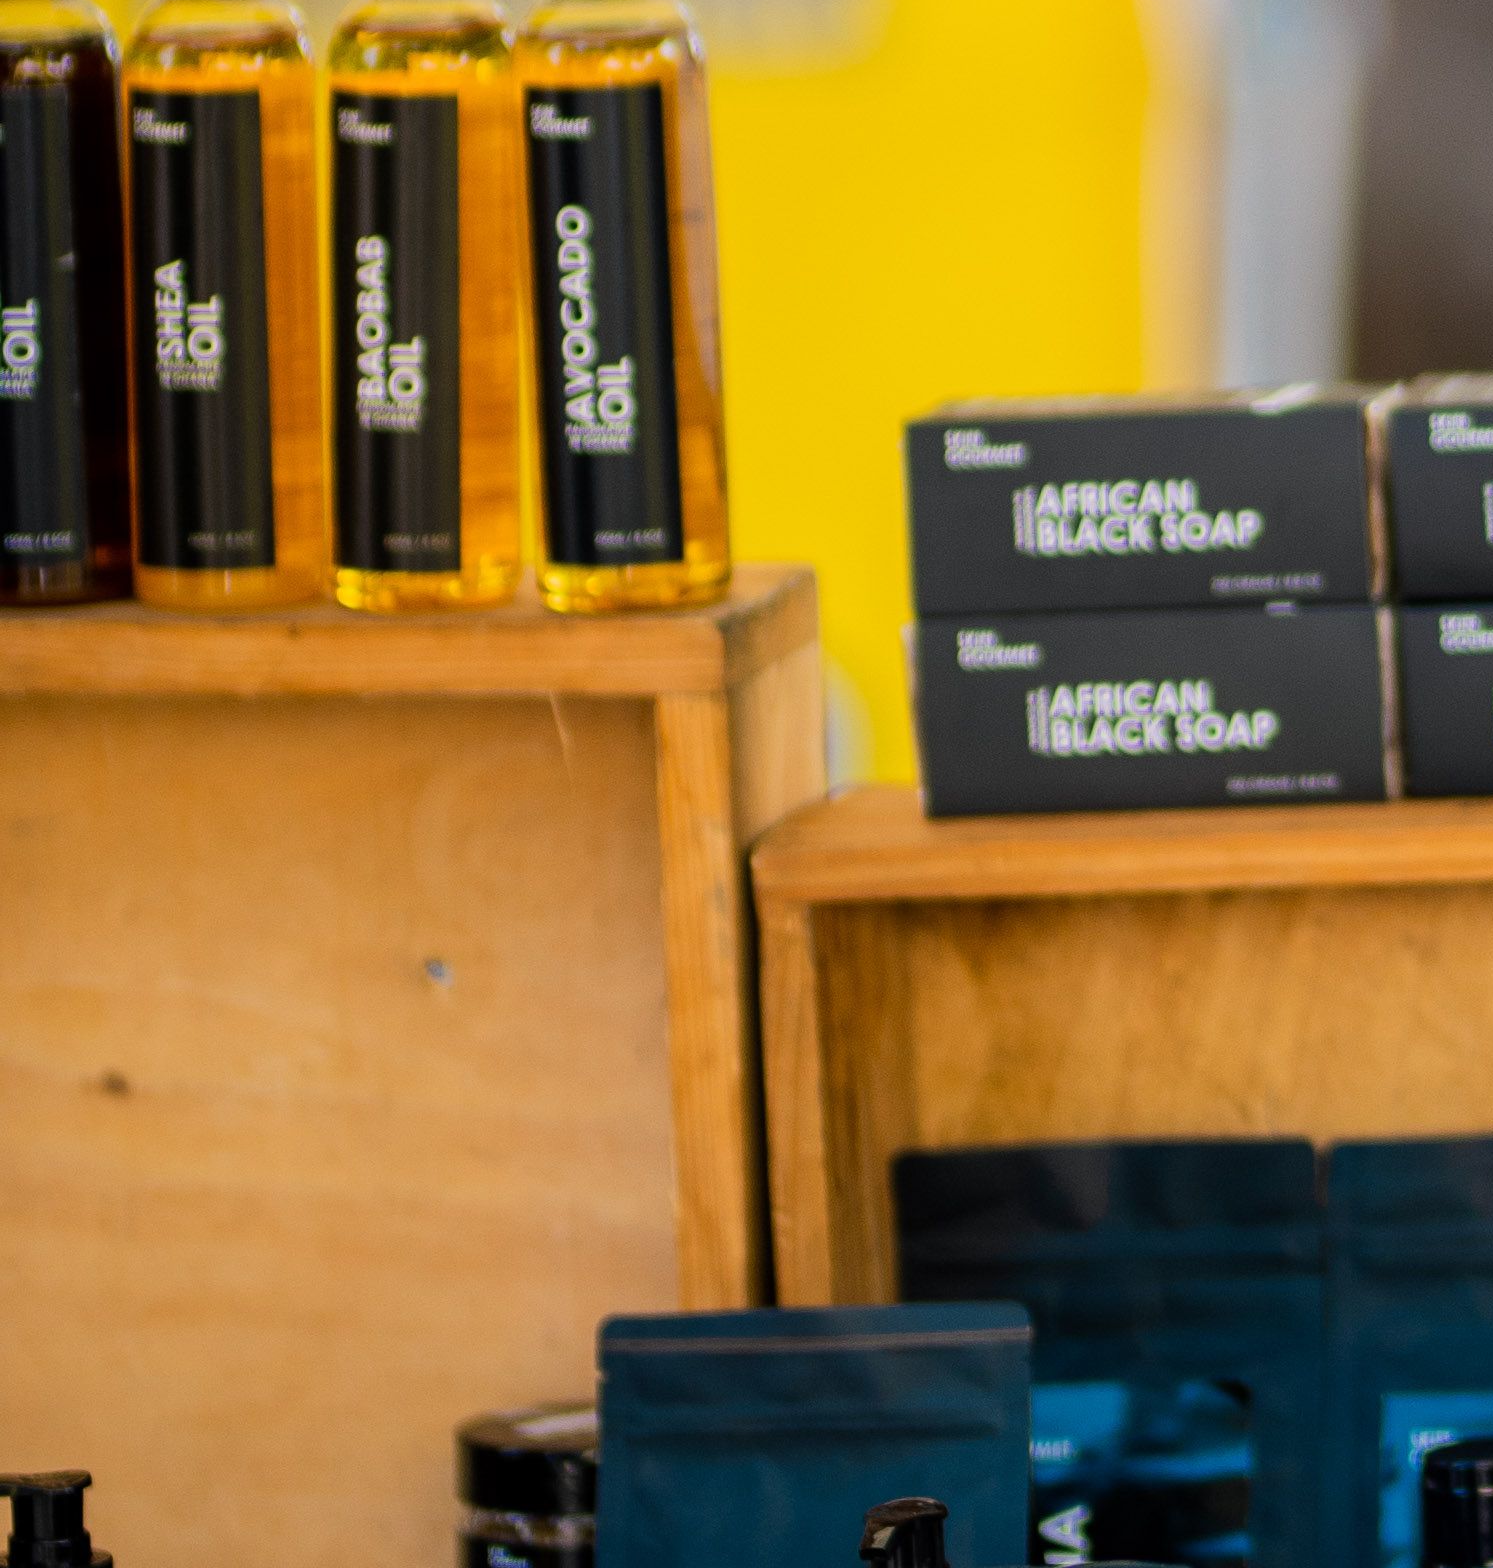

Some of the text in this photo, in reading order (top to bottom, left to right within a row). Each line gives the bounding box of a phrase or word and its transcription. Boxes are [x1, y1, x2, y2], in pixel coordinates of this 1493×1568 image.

[2, 298, 39, 366] OIL
[154, 259, 190, 362] SHEA
[187, 295, 224, 363] OIL
[355, 235, 388, 400] BAOBAB
[556, 204, 597, 425] AVOCADO
[387, 336, 425, 402] OIL
[597, 355, 635, 425] OIL
[1034, 480, 1196, 519] AFRICAN
[1037, 515, 1155, 555] BLACK
[1160, 510, 1263, 551] SOAP
[1050, 680, 1212, 720] AFRICAN
[1051, 715, 1170, 756] BLACK
[1175, 710, 1279, 751] SOAP
